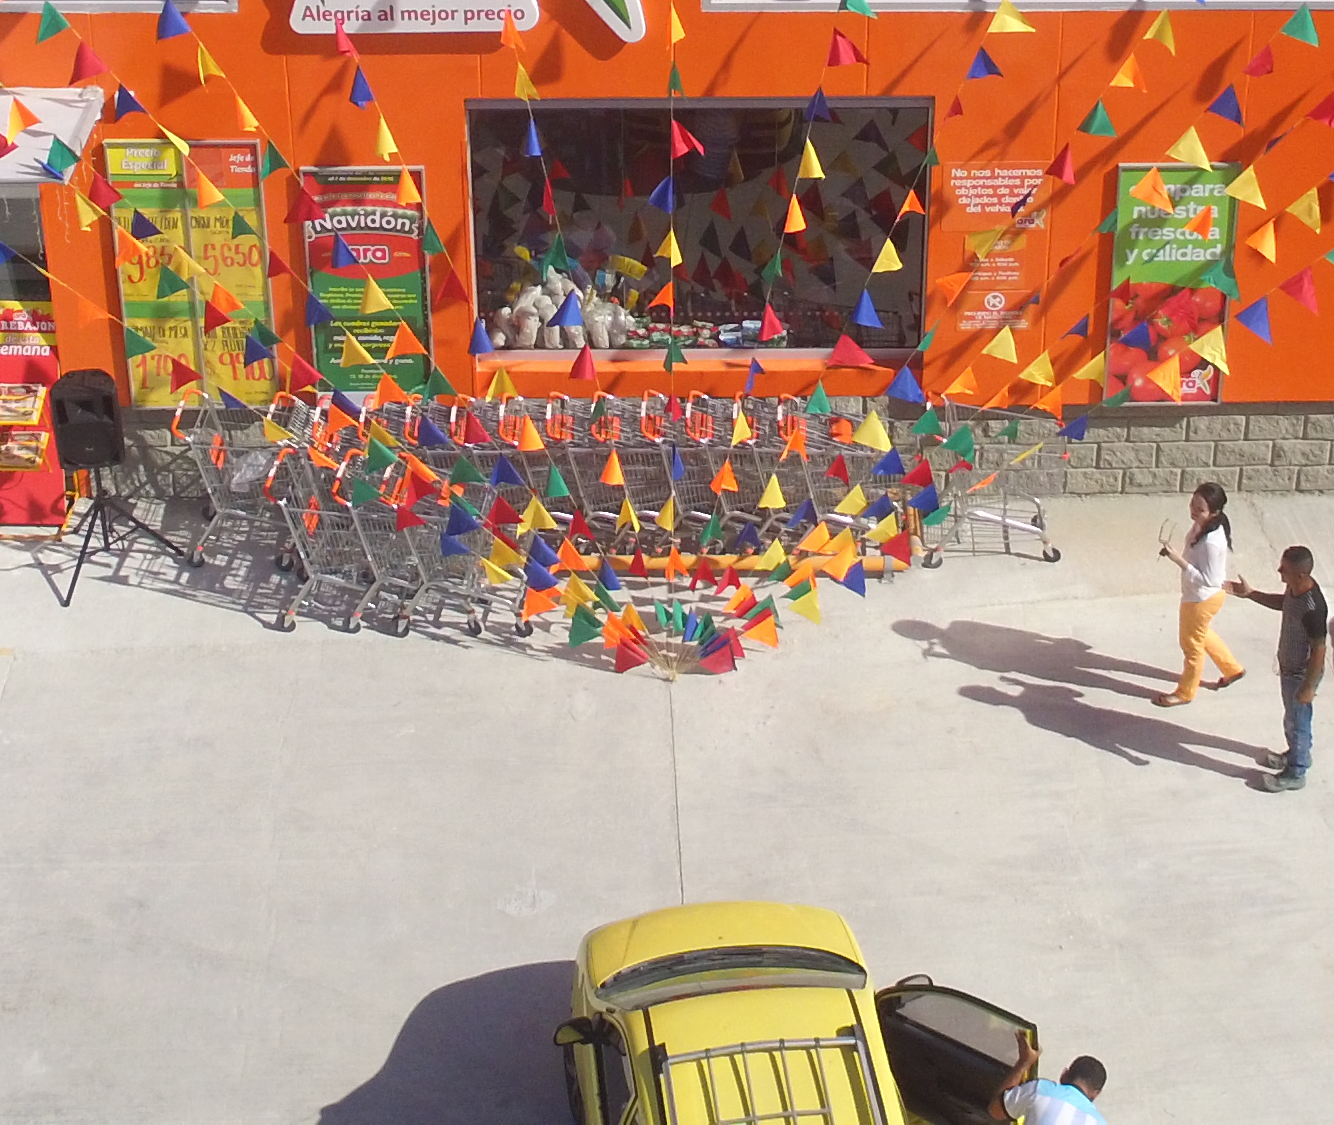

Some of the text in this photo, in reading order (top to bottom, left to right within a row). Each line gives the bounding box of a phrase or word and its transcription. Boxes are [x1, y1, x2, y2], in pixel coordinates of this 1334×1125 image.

[301, 4, 525, 25] Alegría al mejor precio
[126, 148, 162, 158] Precio
[229, 154, 244, 162] Jefe
[122, 159, 168, 171] Especial
[230, 165, 256, 173] Tienda
[951, 168, 1043, 177] No nos hacemos
[950, 177, 1043, 189] responsables por
[955, 187, 994, 196] objetos
[996, 187, 1009, 195] de
[1129, 183, 1226, 201] mpara
[958, 195, 1034, 206] dejados dento
[966, 205, 982, 213] del
[315, 210, 410, 231] Navidón
[1130, 224, 1220, 240] frescua
[203, 243, 262, 277] 5650
[1126, 243, 1222, 265] y calidad
